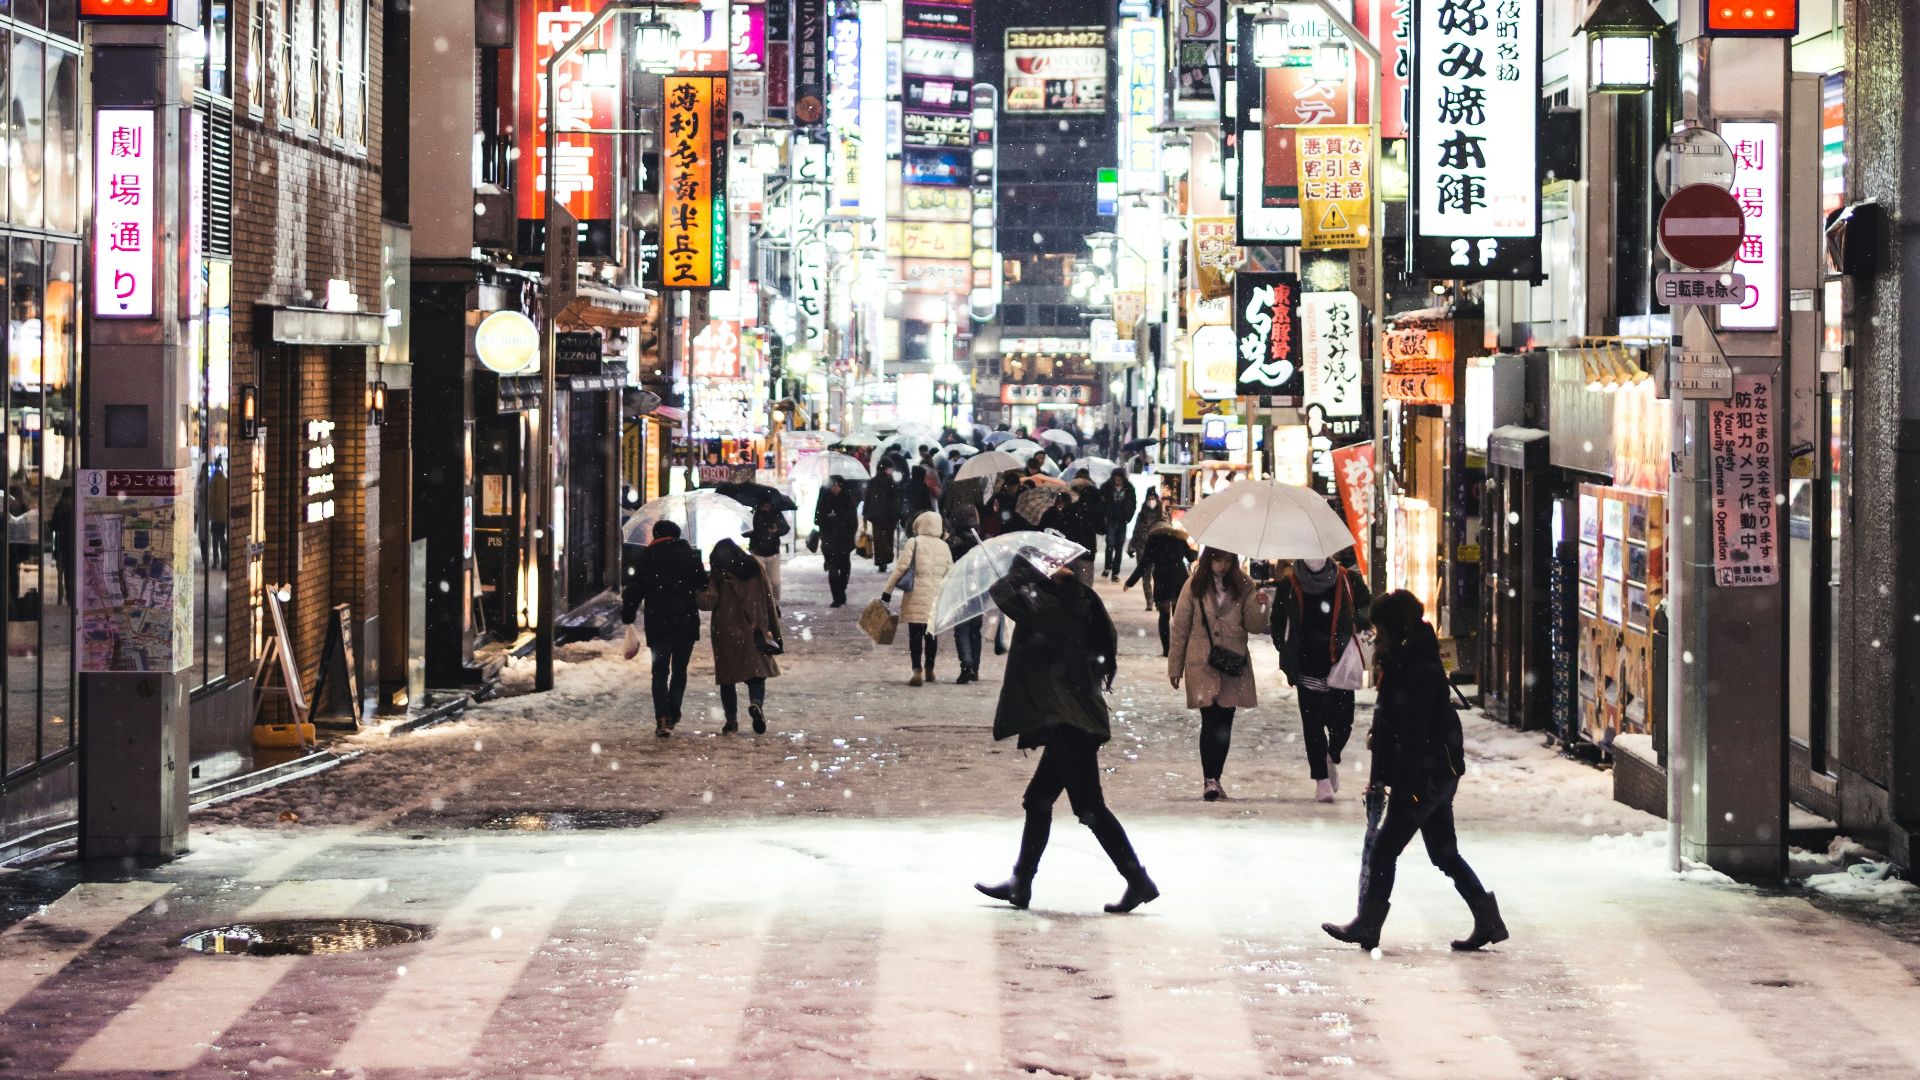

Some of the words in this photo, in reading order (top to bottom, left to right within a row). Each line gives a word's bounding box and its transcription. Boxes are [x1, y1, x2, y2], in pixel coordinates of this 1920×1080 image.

[680, 51, 713, 72] 4F
[1304, 137, 1363, 155] 悪質な
[1304, 159, 1363, 177] 客引き
[1304, 182, 1365, 199] に注意
[110, 126, 142, 299] 劇場通り
[1450, 238, 1498, 266] 2F
[1665, 279, 1740, 298] 自転車を除く
[1271, 283, 1291, 360] 東京豚骨
[1322, 302, 1357, 403] お好み焼き
[1723, 399, 1732, 409] or
[1332, 421, 1361, 435] B1F
[1713, 410, 1725, 452] Security
[1724, 413, 1734, 436] Your
[1724, 439, 1736, 472] Safety
[1714, 456, 1725, 495] Camera
[1735, 391, 1757, 550] 防犯カメラ作動中
[1753, 382, 1773, 559] みなさまの安全を守ります
[1717, 498, 1726, 508] in
[1715, 511, 1728, 561] Operation
[1734, 575, 1764, 583] Police
